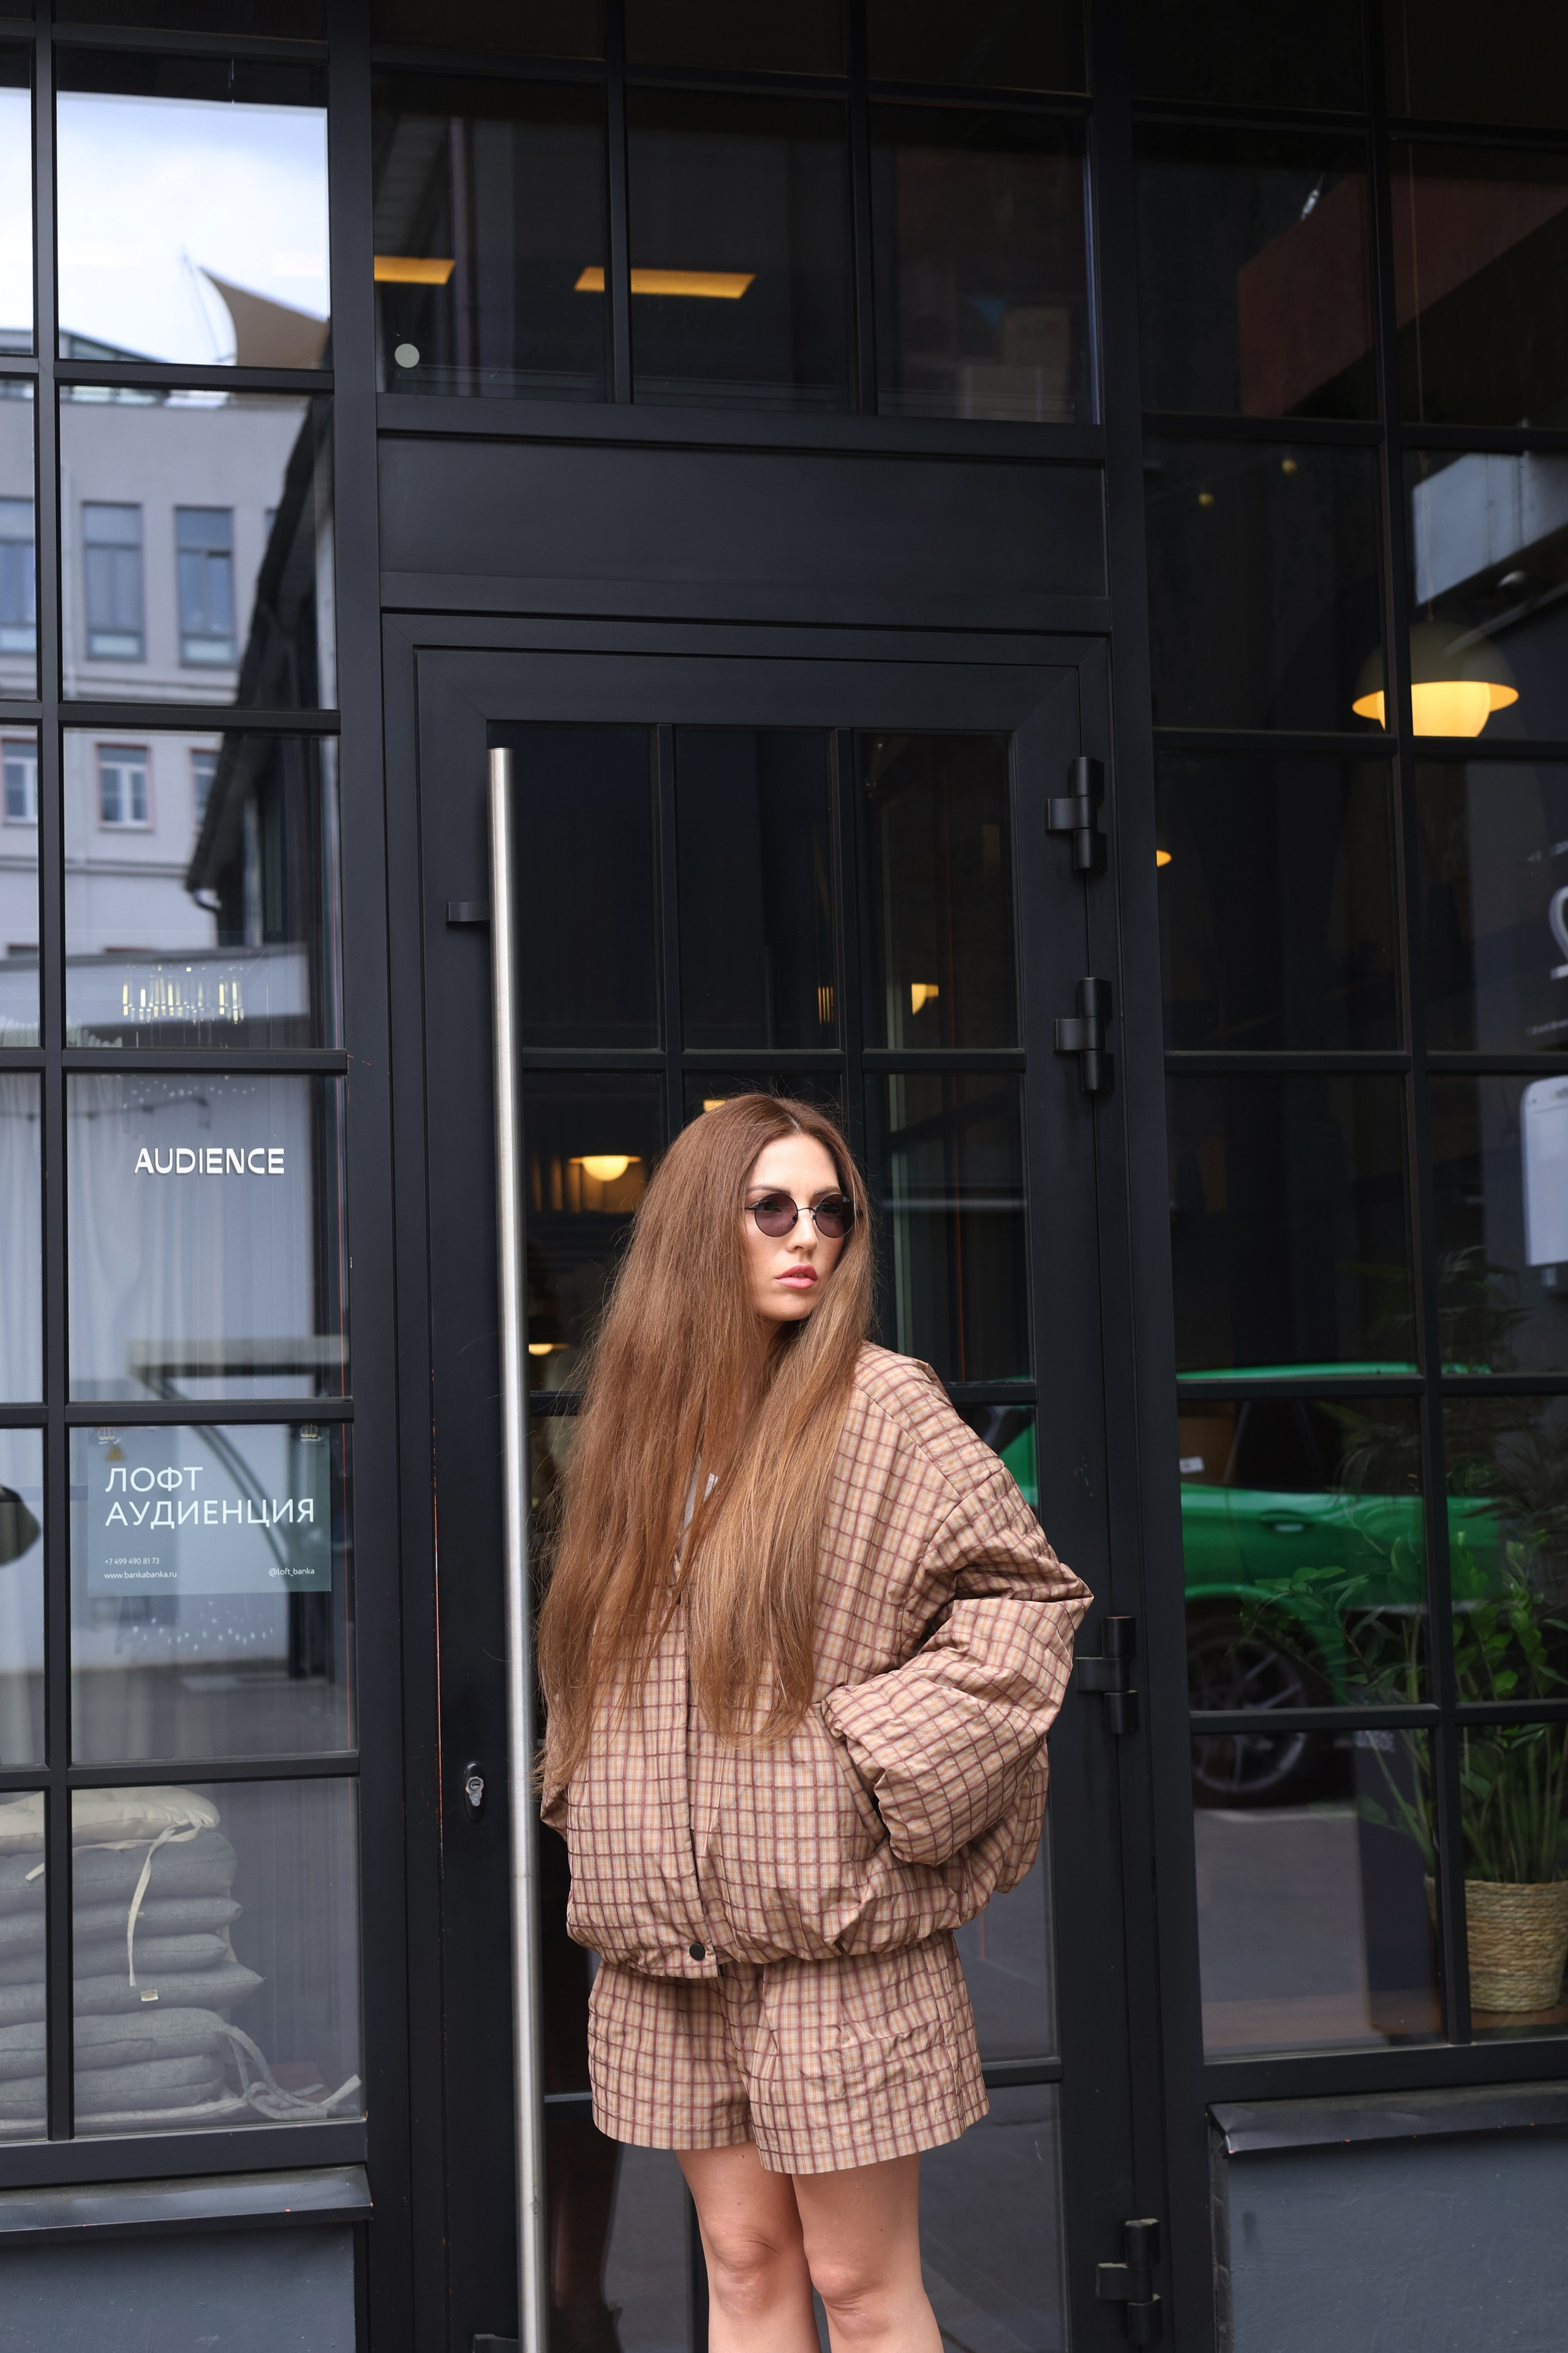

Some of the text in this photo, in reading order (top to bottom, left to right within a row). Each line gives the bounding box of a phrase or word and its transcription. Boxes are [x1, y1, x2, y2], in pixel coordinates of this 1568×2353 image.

[134, 1147, 285, 1174] AUDIENCE
[105, 1467, 203, 1492] ЛОФТ
[105, 1498, 314, 1530] АУДИЕНЦИЯ
[104, 1570, 177, 1579] www.bankabanka.ru
[268, 1567, 315, 1577] @loft_banka
